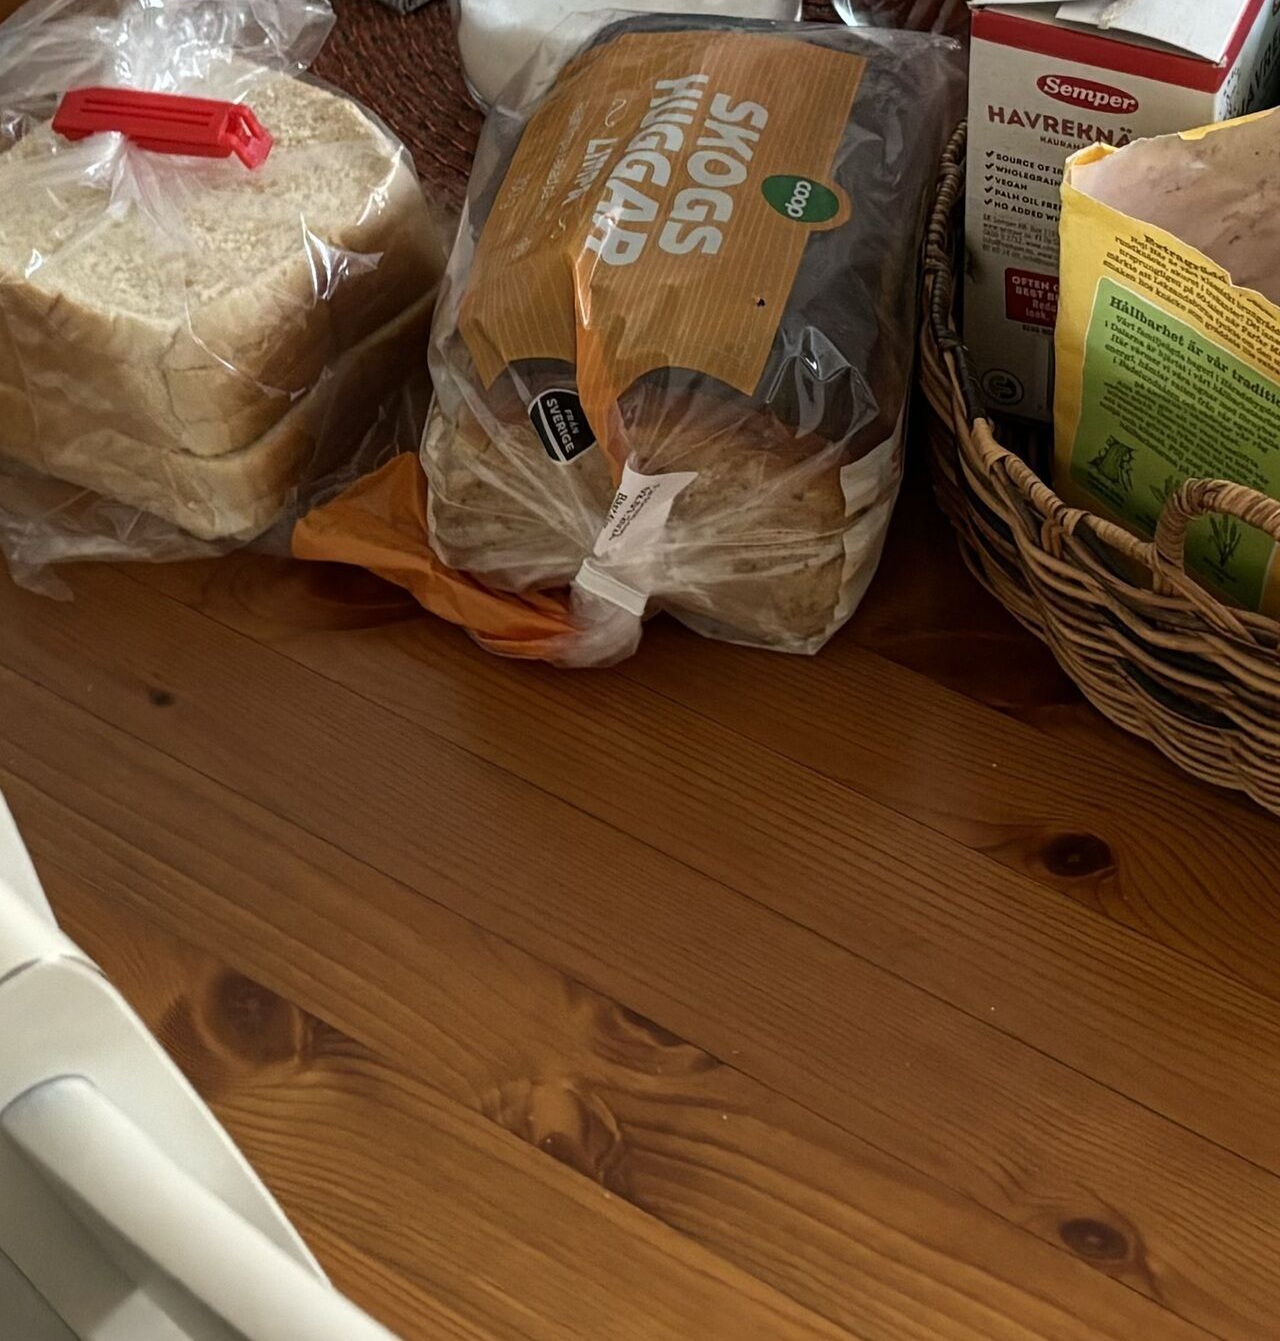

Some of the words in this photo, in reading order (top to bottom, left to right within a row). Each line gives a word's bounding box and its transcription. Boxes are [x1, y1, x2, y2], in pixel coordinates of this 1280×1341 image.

[1042, 76, 1136, 111] Semper
[987, 104, 1133, 149] HAVREKNÄ
[585, 73, 710, 267] HUGGAR
[657, 91, 769, 257] SKOGS
[996, 153, 1035, 169] SOURCE
[1037, 163, 1051, 172] OF
[787, 179, 812, 218] coop
[994, 176, 1028, 191] VEGAN
[994, 188, 1021, 202] PALM
[1021, 196, 1039, 207] OIL
[994, 200, 1009, 211] NO
[1010, 205, 1044, 219] ADDED
[1109, 295, 1185, 346] Hållbarhet
[1187, 338, 1204, 357] är
[1206, 353, 1229, 374] vår
[546, 397, 575, 454] SVERIGE
